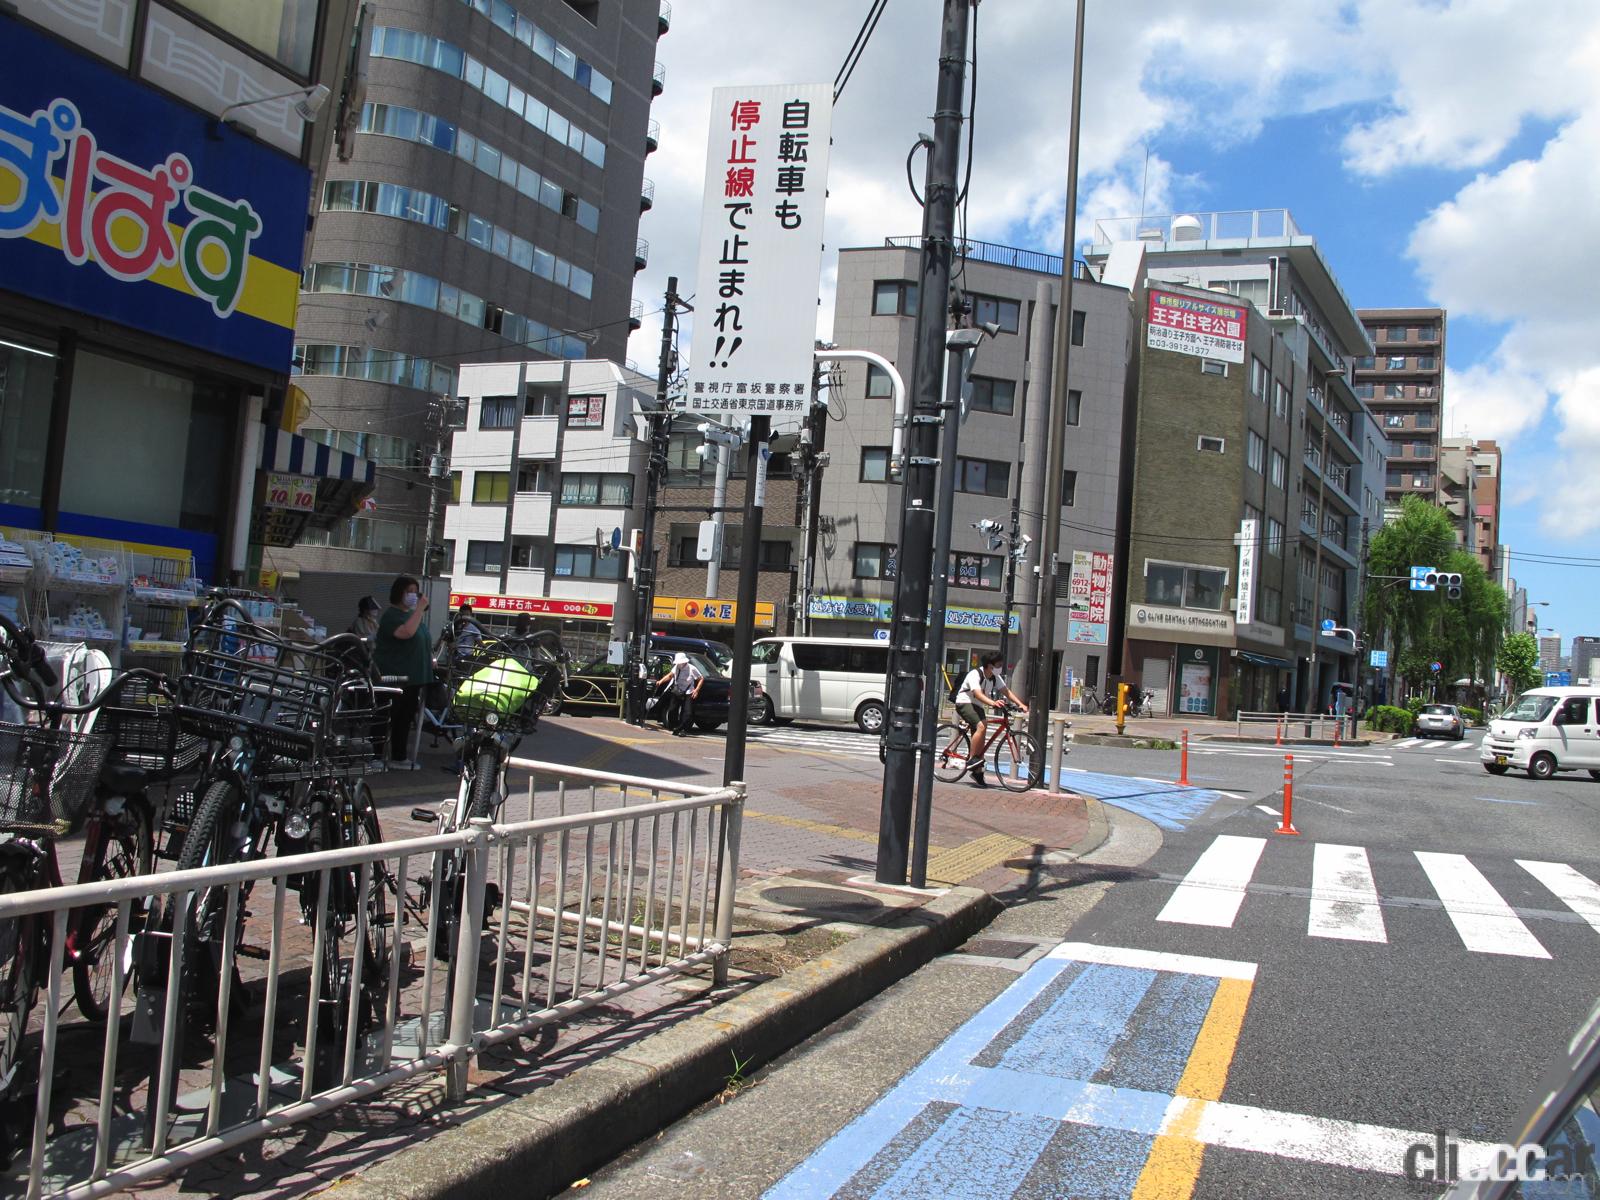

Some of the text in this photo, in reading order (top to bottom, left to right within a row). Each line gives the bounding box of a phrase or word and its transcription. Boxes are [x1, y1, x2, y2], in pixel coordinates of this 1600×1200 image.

[775, 99, 810, 230] 自転車も
[709, 100, 761, 368] 停止線で止まれ!!
[1152, 306, 1241, 338] 王子住宅公園
[694, 382, 805, 395] 警視庁富坂警察署
[692, 397, 804, 411] 国土交通省東京国道事務所
[1071, 586, 1088, 595] 1122
[1090, 555, 1107, 623] 動物病院
[702, 604, 732, 619] 松屋
[811, 602, 877, 616] 処方せん受付
